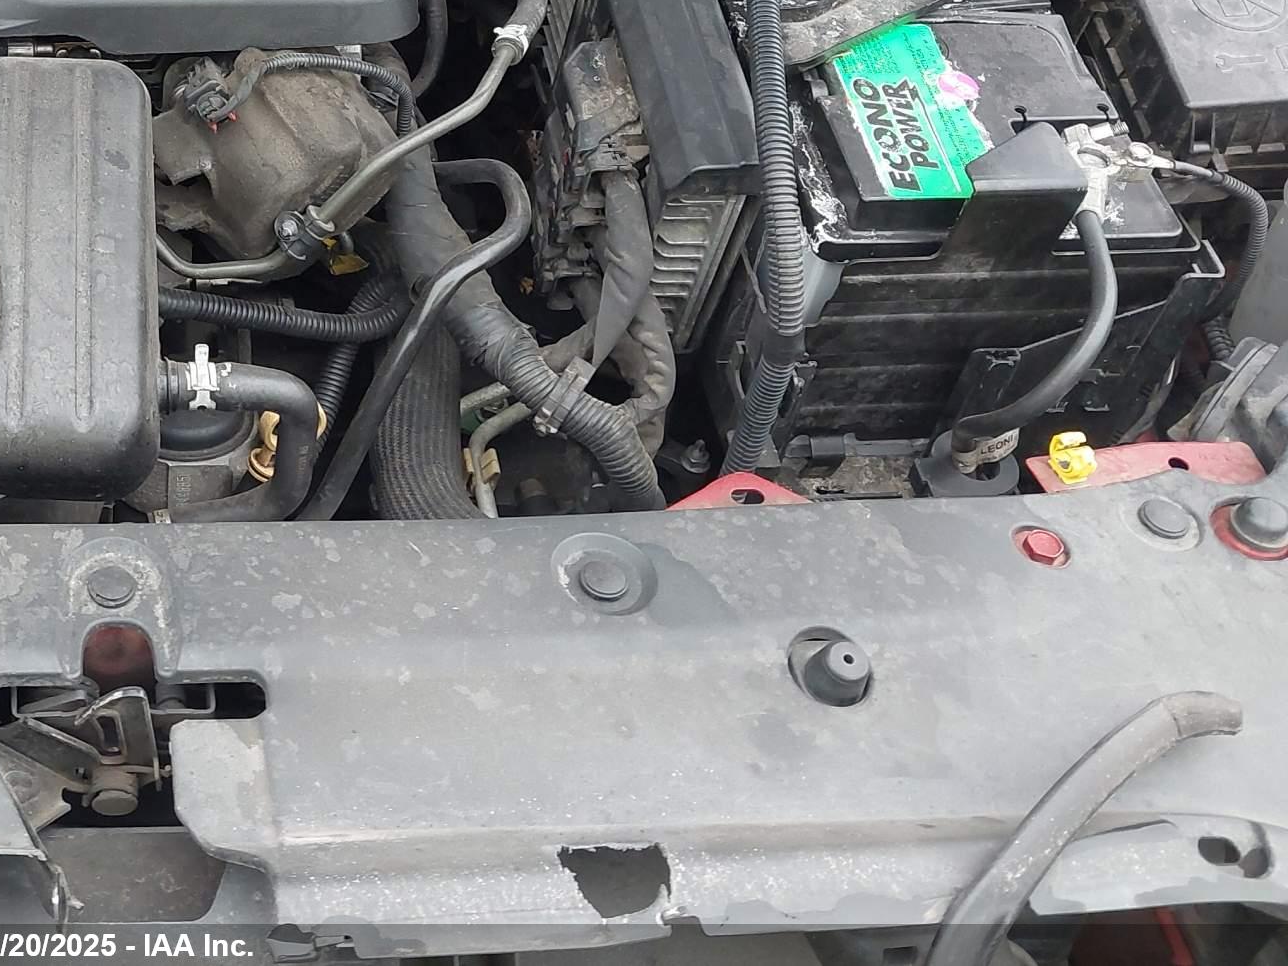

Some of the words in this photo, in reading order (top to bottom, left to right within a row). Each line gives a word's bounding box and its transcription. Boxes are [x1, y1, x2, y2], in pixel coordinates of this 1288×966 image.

[853, 78, 921, 192] ECONO
[882, 78, 940, 169] POWER
[980, 434, 1014, 454] LEONI
